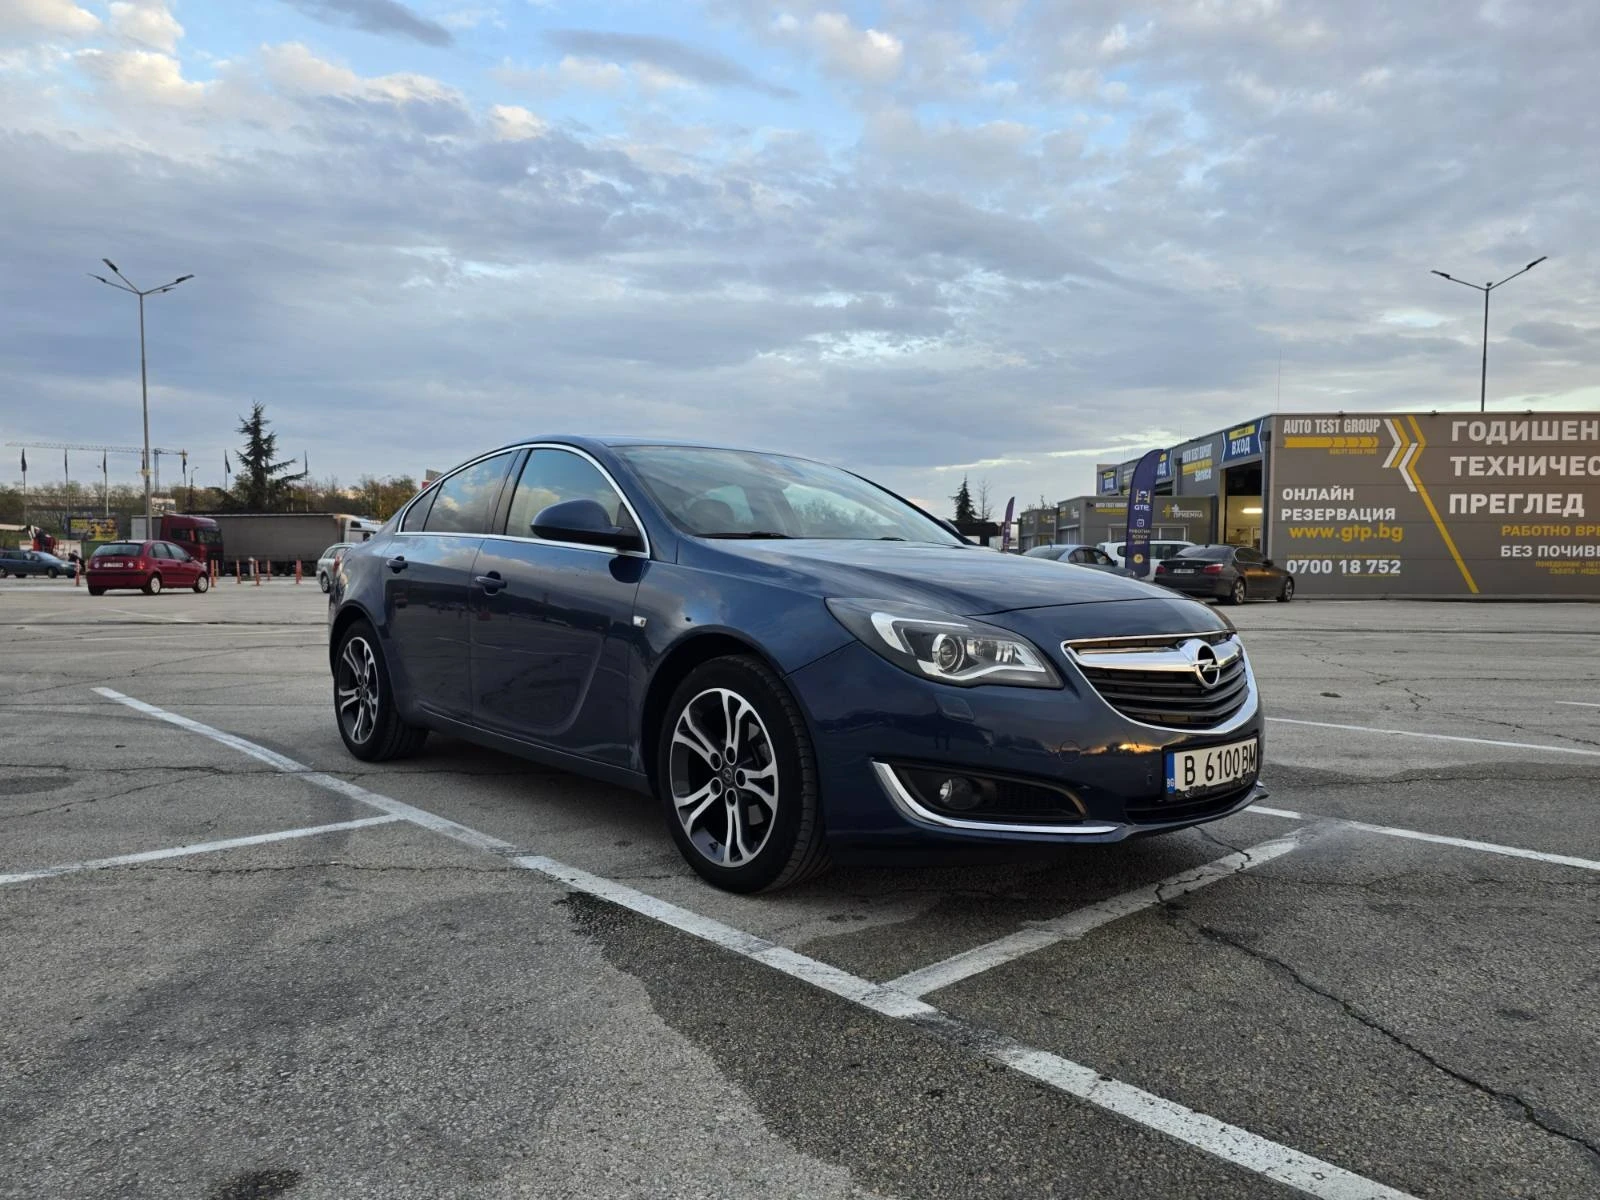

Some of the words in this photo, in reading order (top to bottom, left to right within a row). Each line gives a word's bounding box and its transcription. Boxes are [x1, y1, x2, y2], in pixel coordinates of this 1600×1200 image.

[1283, 419, 1312, 434] AUTO
[1315, 419, 1340, 434] TEST
[1343, 418, 1381, 433] GROUP
[1451, 420, 1599, 445] ГОДИШЕН
[1231, 436, 1251, 456] ВХОД
[1282, 485, 1354, 501] ОНЛАЙН
[1449, 493, 1585, 518] ПРЕГЛЕД
[1281, 507, 1396, 522] РЕЗЕРВАЦИЯ
[1288, 522, 1404, 542] www.gtp.bg
[1502, 525, 1571, 537] РАБОТНО
[1501, 545, 1533, 557] БЕЗ
[1286, 559, 1333, 574] 0700
[1339, 559, 1361, 574] 18
[1366, 559, 1401, 574] 752
